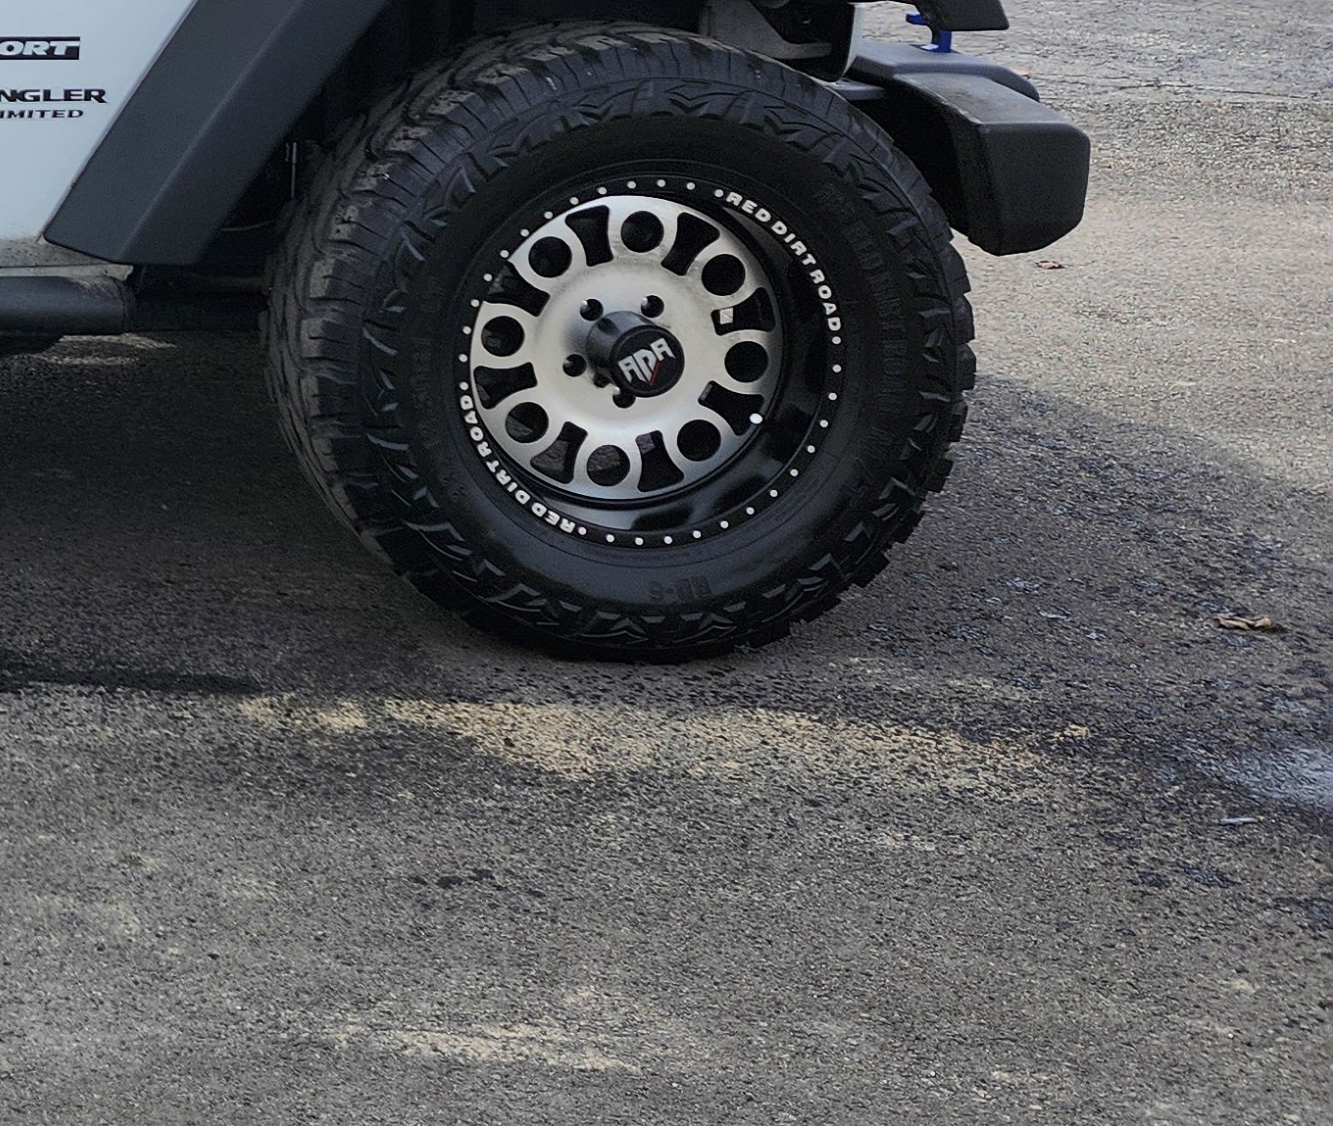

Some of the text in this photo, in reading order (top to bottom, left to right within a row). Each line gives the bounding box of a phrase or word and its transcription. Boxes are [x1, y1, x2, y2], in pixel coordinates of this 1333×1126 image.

[725, 191, 842, 331] RED DIRT ROAD
[460, 394, 576, 534] RED DIRT ROAD
